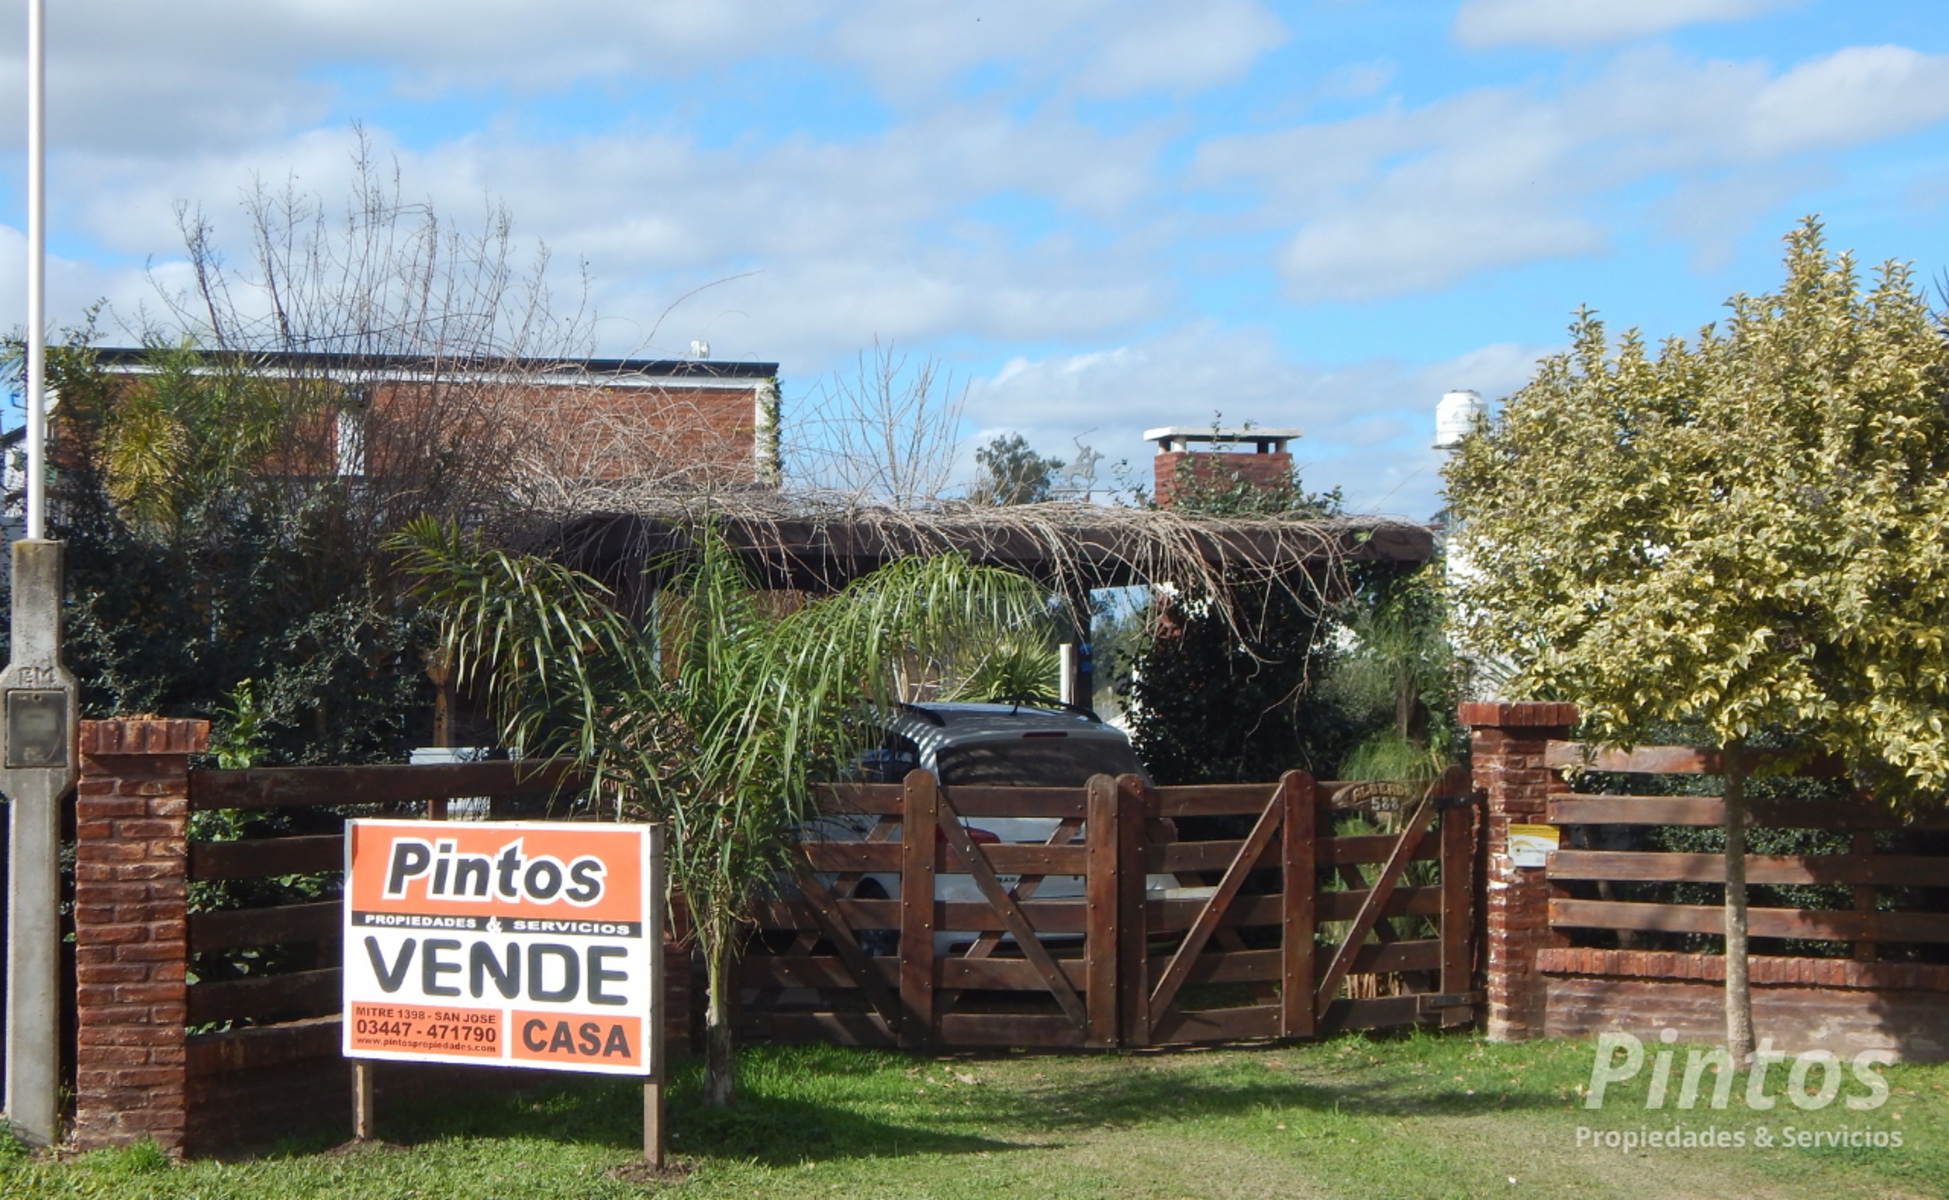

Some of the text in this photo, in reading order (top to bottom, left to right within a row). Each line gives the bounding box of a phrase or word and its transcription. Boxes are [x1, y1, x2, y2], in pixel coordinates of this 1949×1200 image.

[384, 838, 606, 906] Pintos
[364, 914, 631, 936] PROPIEDADES & SERVICIOS
[364, 935, 628, 1006] VENDE
[356, 1006, 394, 1018] MITRE
[397, 1009, 426, 1020] 1398
[434, 1011, 460, 1022] SAN
[463, 1013, 497, 1025] JOSE
[356, 1019, 413, 1037] 03447
[426, 1023, 497, 1043] 471790
[522, 1018, 632, 1059] CASA
[356, 1036, 497, 1053] www.pintospropiedades.com
